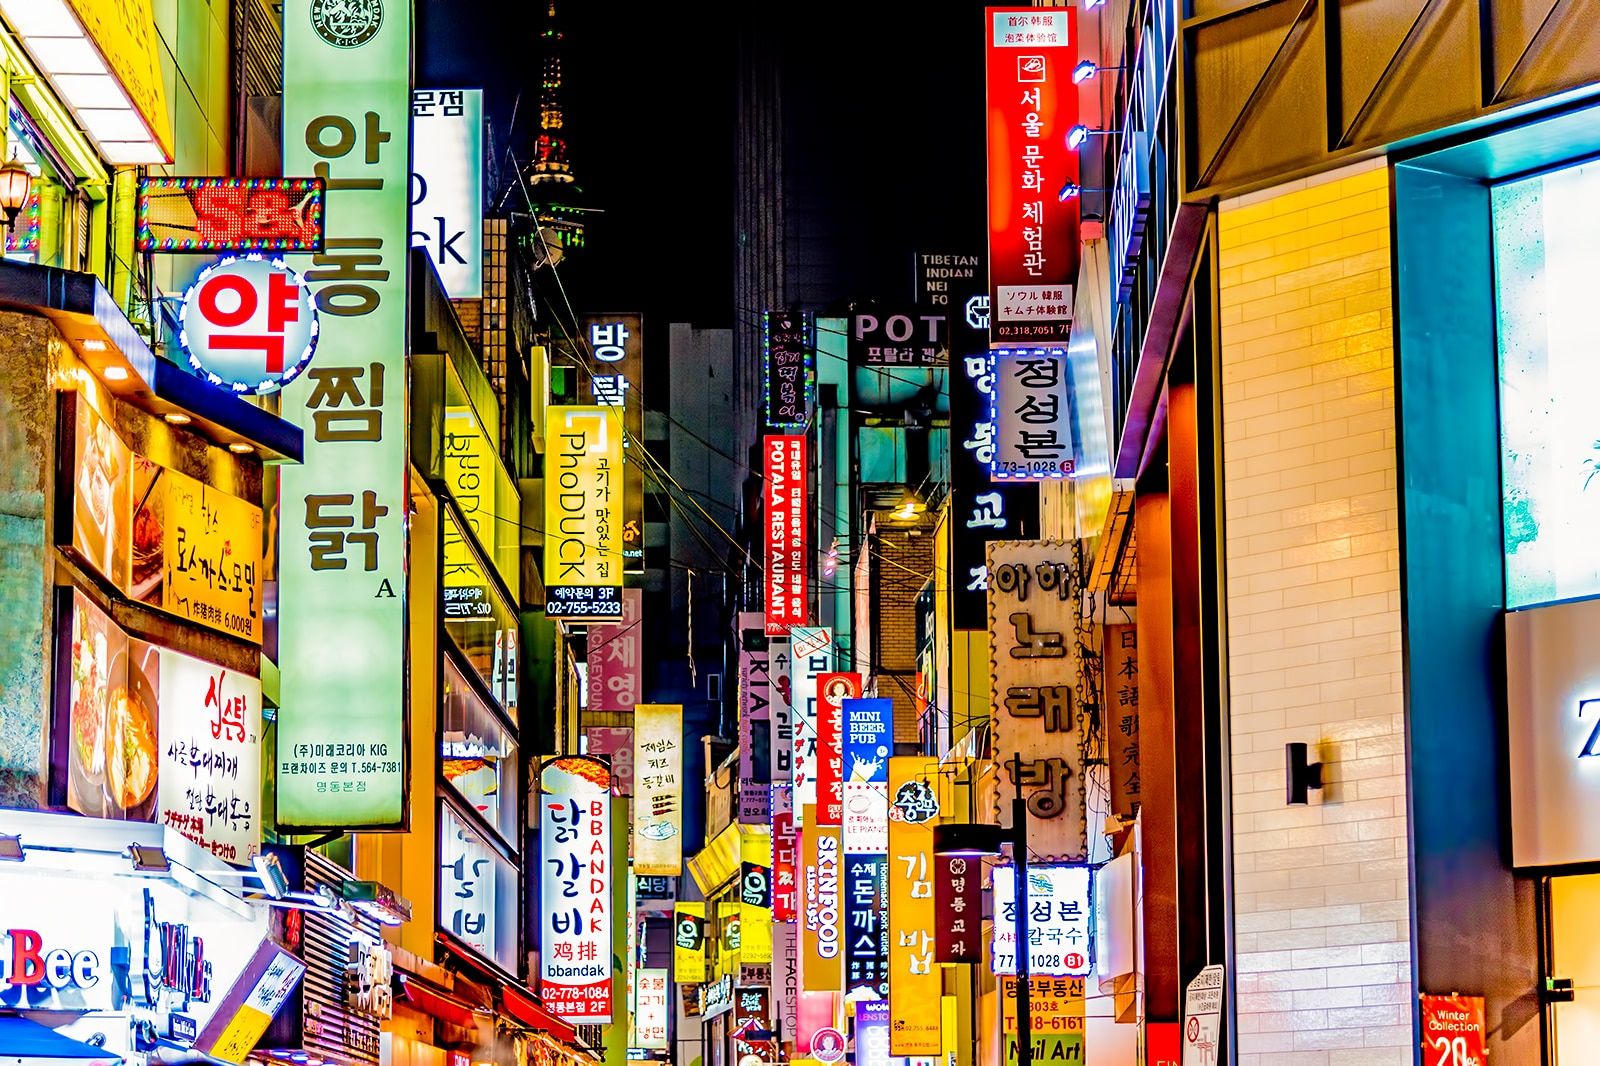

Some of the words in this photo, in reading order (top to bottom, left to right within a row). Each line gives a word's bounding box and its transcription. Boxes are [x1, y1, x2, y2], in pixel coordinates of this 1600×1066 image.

[1021, 87, 1044, 137] 서울
[1022, 146, 1045, 193] 문화
[922, 254, 978, 266] TIBETAN
[926, 268, 973, 278] INDIAN
[1007, 290, 1038, 300] ソウル
[1042, 290, 1063, 300] 韓服
[1003, 304, 1068, 316] キムチ体験館
[199, 272, 299, 374] 약
[999, 327, 1054, 336] 02.318.7051
[304, 111, 392, 572] 안동찜닭
[868, 347, 914, 363] 포탈라
[1014, 358, 1066, 459] 정성본
[595, 458, 611, 502] 고기가
[771, 441, 785, 506] POTALA
[559, 431, 586, 578] PhoDUCK
[595, 508, 611, 557] 맛있는
[596, 561, 610, 577] 집
[771, 511, 786, 618] RESTAURANT
[996, 561, 1070, 601] 아하
[555, 587, 594, 600] 예약문의
[598, 587, 615, 600] 3F
[546, 601, 621, 614] 02-755-5233
[849, 711, 881, 722] MINI
[1004, 612, 1073, 819] 노래방
[849, 723, 886, 733] BEER
[849, 733, 877, 744] PUB
[294, 743, 366, 758] (주)미래코리아
[370, 743, 388, 757] KIG
[547, 798, 587, 937] 닭갈비
[590, 801, 605, 934] BBANDAK
[851, 863, 877, 877] 수제
[818, 836, 839, 958] SKINFOOD
[852, 879, 877, 956] 돈까스
[897, 852, 934, 976] 김밥
[951, 878, 967, 957] 명동교자
[553, 941, 598, 961] 鸡排
[548, 965, 604, 977] bbandak
[542, 987, 609, 1000] 02-778-1084
[590, 1001, 606, 1013] 2F
[1437, 1009, 1470, 1020] Winter
[1428, 1019, 1480, 1031] Collection
[1051, 1040, 1081, 1060] Art
